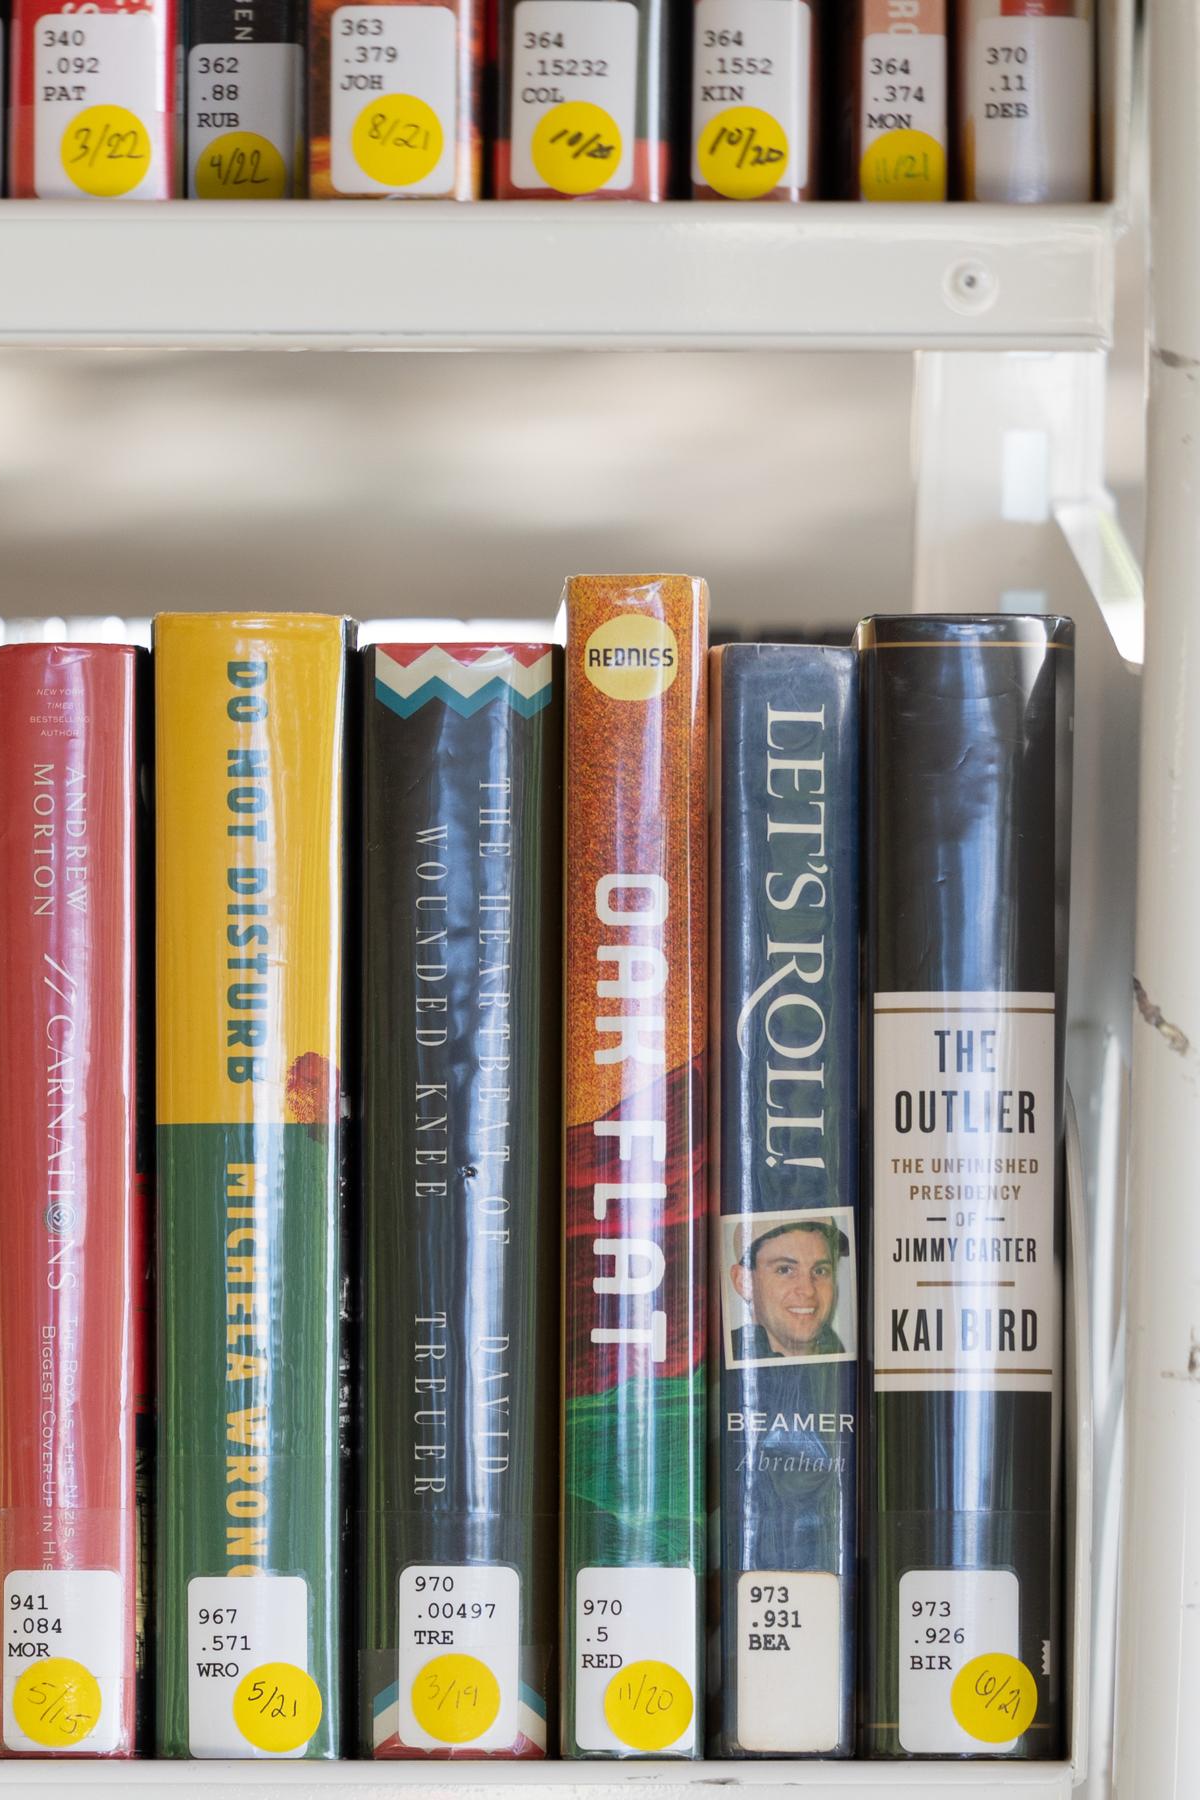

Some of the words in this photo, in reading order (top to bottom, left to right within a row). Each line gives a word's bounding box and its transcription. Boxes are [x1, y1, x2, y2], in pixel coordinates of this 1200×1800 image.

[341, 19, 383, 36] 363
[43, 30, 84, 47] 340
[524, 32, 563, 49] 364
[703, 30, 743, 48] 364
[344, 46, 397, 63] .379
[986, 47, 1027, 65] 370
[46, 57, 98, 74] .092
[198, 57, 238, 74] 362
[526, 59, 607, 76] .15232
[704, 57, 772, 75] .1552
[340, 75, 383, 91] JOH
[989, 75, 1026, 92] .11
[43, 86, 85, 101] PAT
[202, 84, 238, 101] .88
[521, 87, 564, 104] COL
[700, 86, 743, 102] KIN
[984, 102, 1028, 119] DEB
[197, 113, 239, 128] RUB
[368, 113, 429, 152] 8/21
[71, 123, 144, 166] 3/22
[208, 151, 271, 185] 4/22
[589, 648, 674, 667] REDNISS
[227, 661, 268, 723] DO
[227, 750, 268, 841] NOT
[479, 779, 510, 857] THE
[416, 824, 448, 1048] WOUNDED
[227, 868, 268, 1084] DISTURB
[594, 874, 669, 1065] OAK
[479, 894, 511, 1164] HEARTBEAT
[736, 934, 826, 1169] ROLL!
[934, 1030, 995, 1072] THE
[895, 1090, 1035, 1135] OUTLIER
[416, 1082, 448, 1197] KNEE
[480, 1196, 509, 1245] OF
[591, 1120, 668, 1362] FLAT
[893, 1238, 958, 1264] JIMMY
[965, 1238, 1037, 1264] CARTER
[892, 1309, 943, 1352] KAI
[962, 1309, 1038, 1352] BIRD
[728, 1413, 854, 1433] BEAMER
[199, 1609, 236, 1624] 967
[912, 1601, 950, 1617] 973
[202, 1635, 251, 1651] .571
[915, 1628, 964, 1644] .926
[197, 1663, 239, 1677] WRO
[910, 1656, 952, 1670] BIR
[249, 1681, 297, 1718] 5/21
